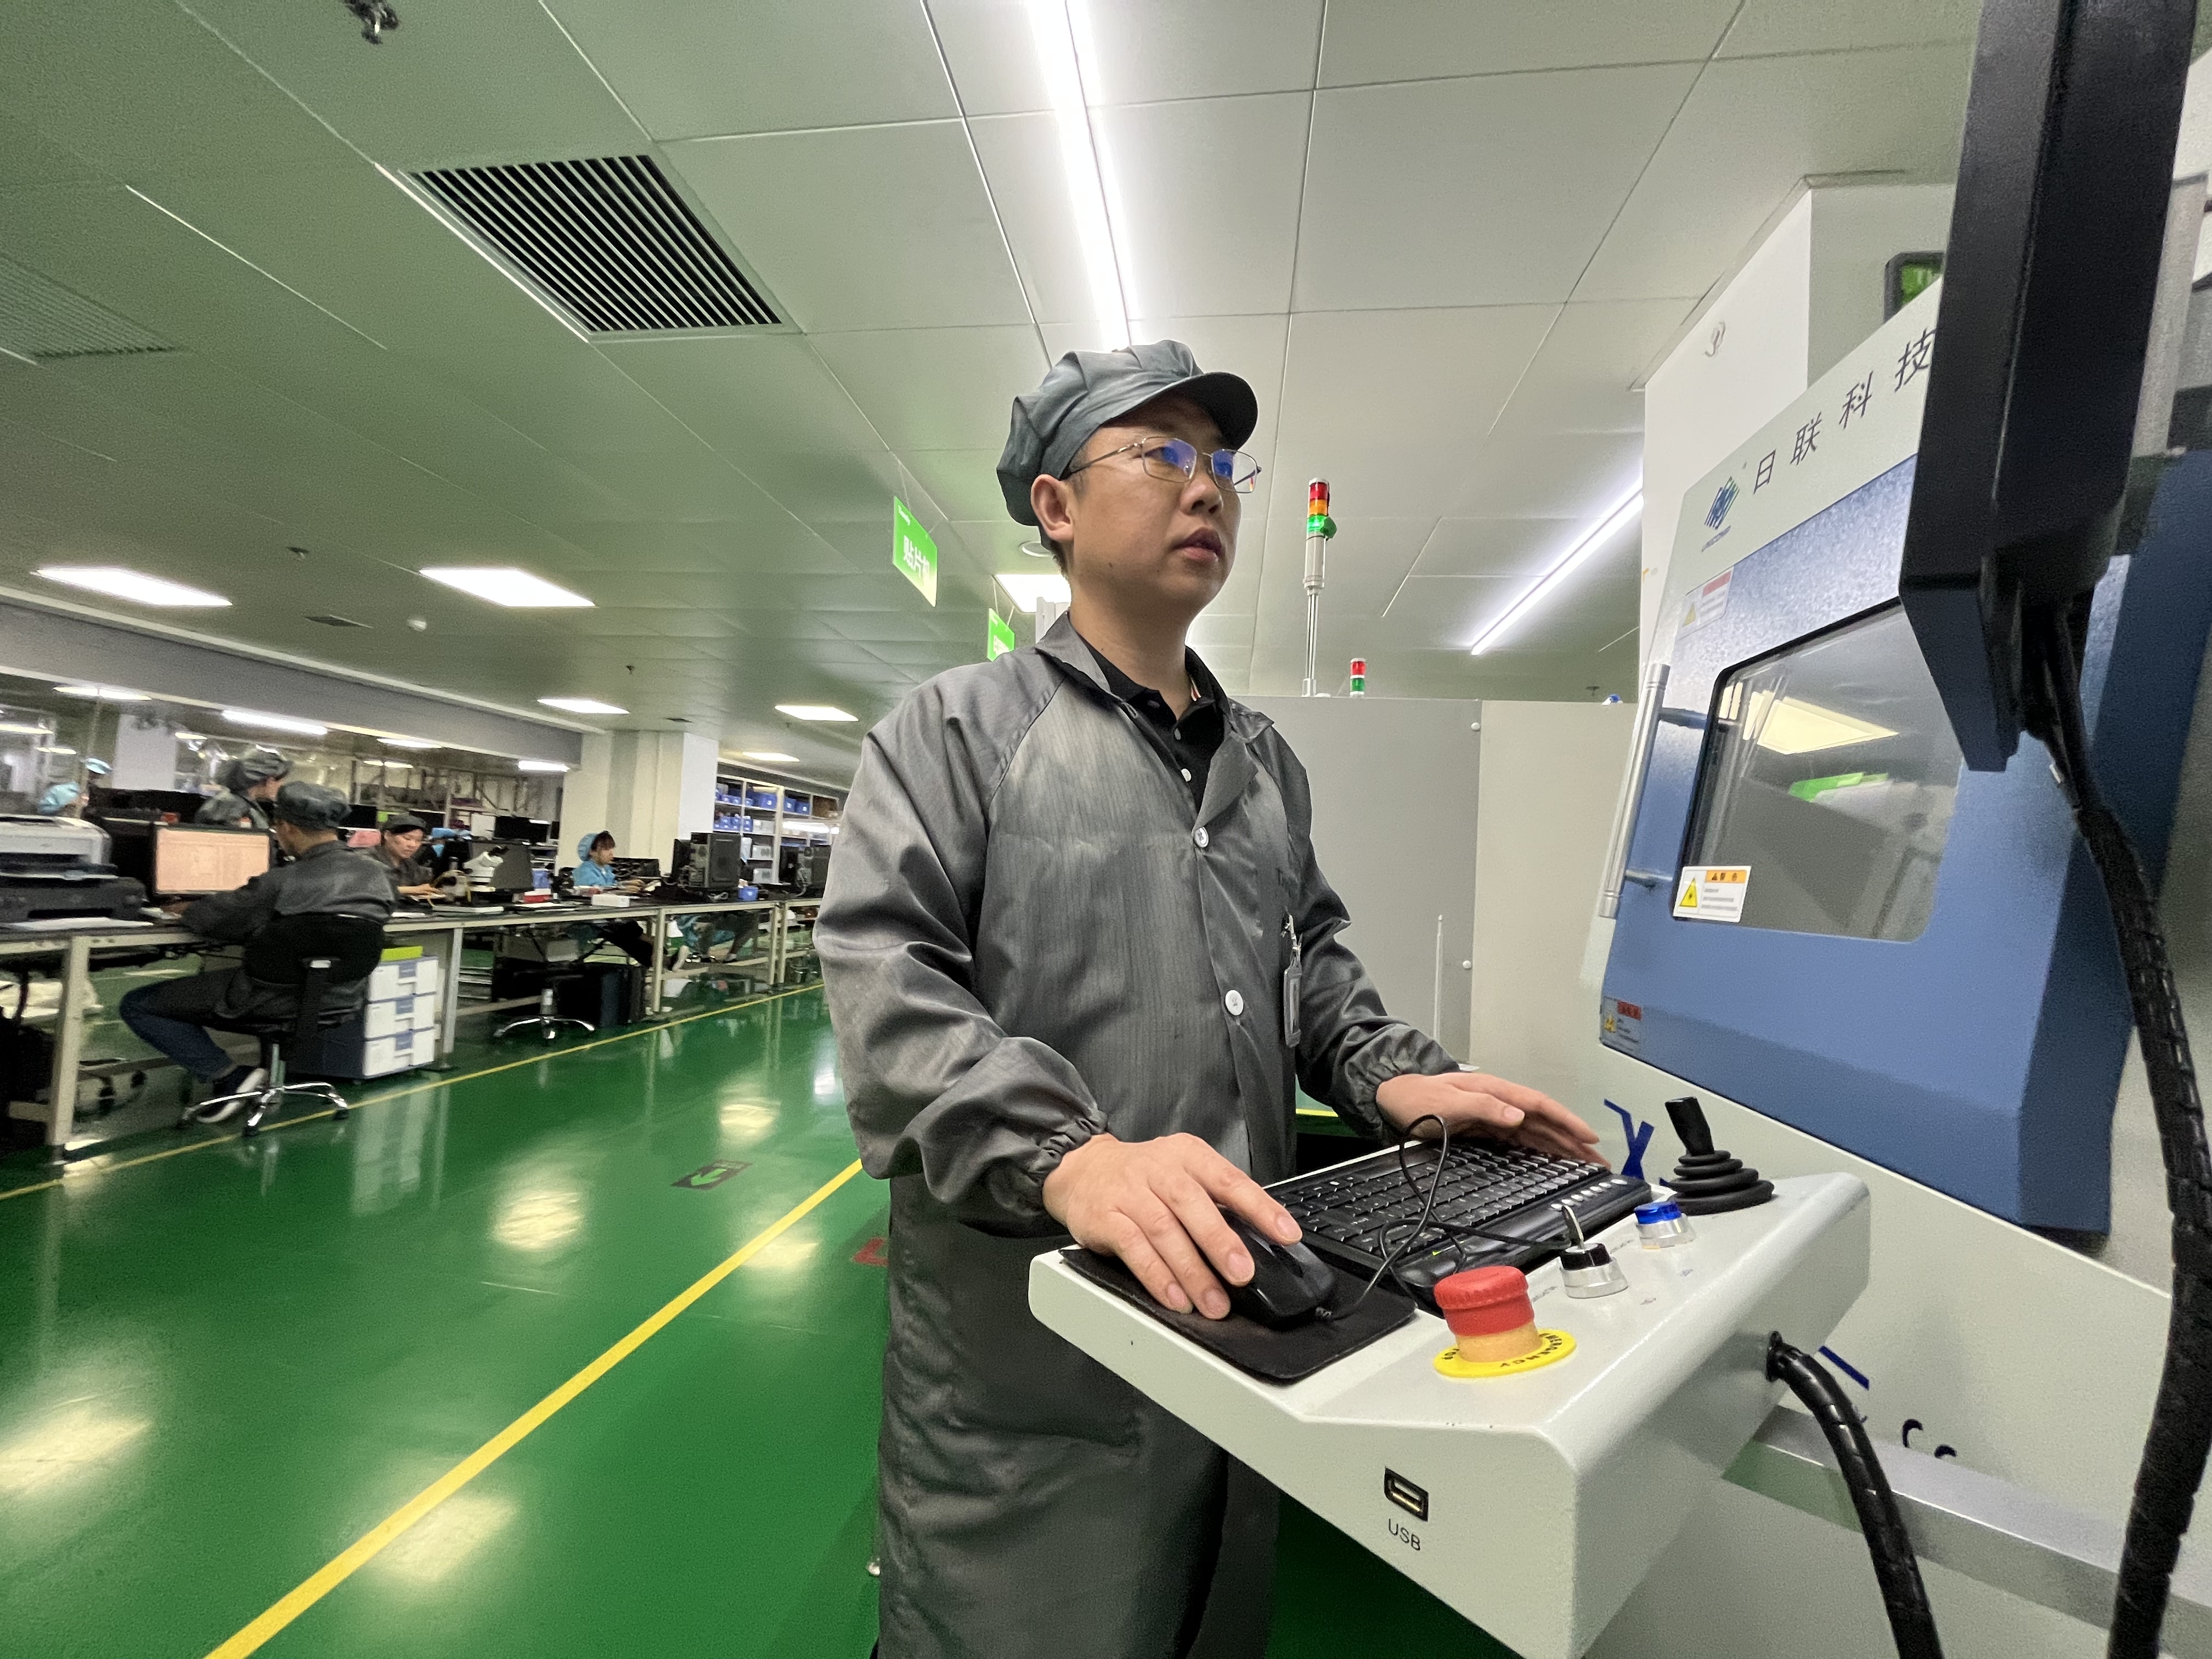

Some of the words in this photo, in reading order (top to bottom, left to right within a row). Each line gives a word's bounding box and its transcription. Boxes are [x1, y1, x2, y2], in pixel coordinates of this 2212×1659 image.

[1753, 328, 1937, 494] 日联科技
[1388, 1519, 1421, 1551] USB
